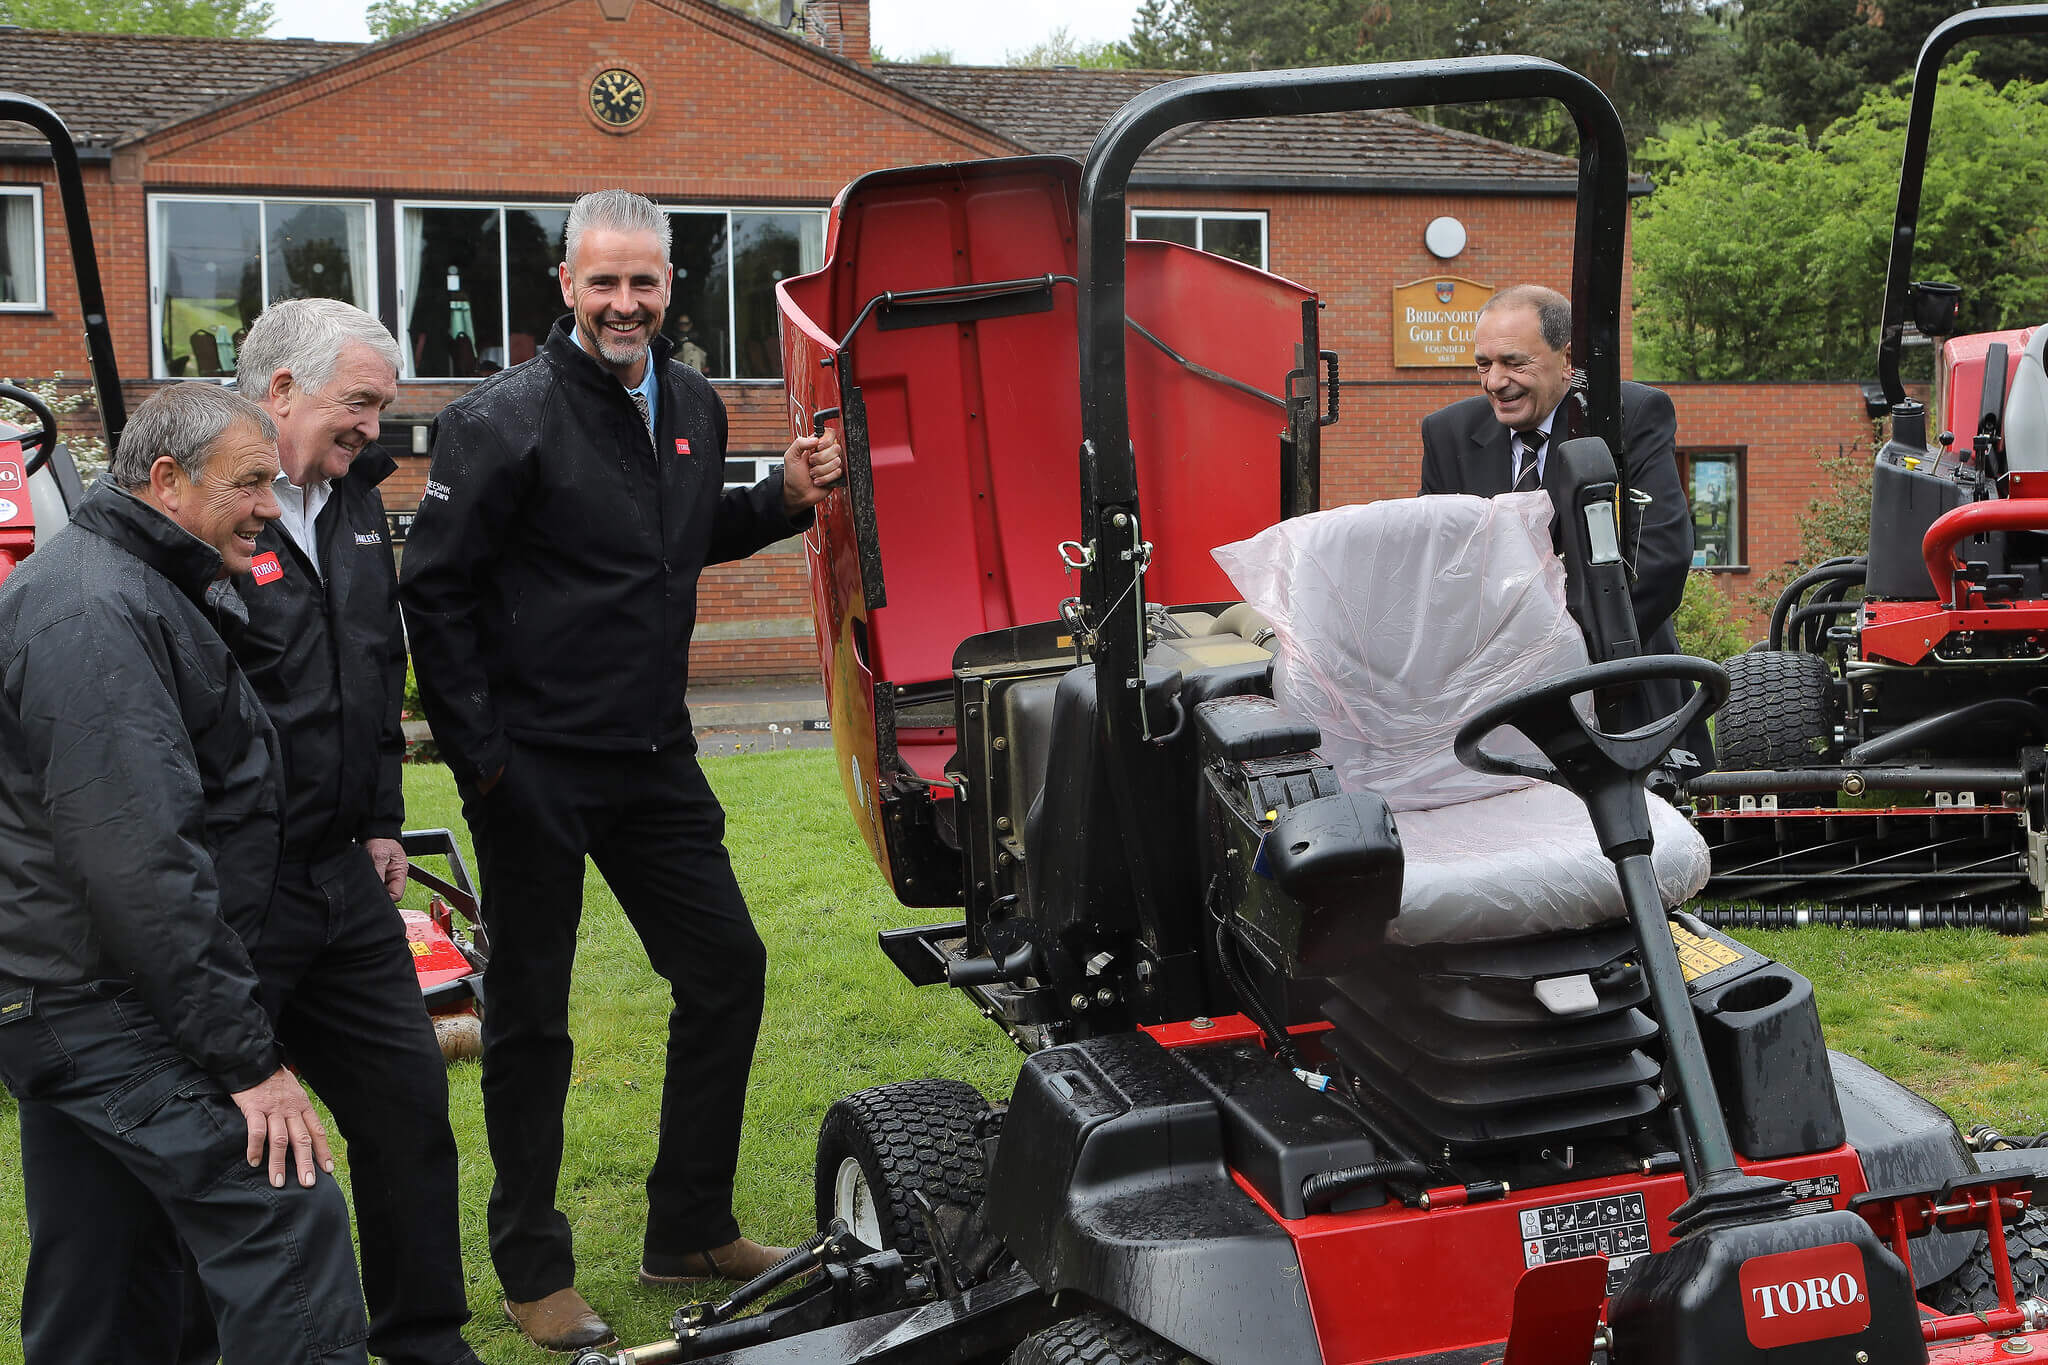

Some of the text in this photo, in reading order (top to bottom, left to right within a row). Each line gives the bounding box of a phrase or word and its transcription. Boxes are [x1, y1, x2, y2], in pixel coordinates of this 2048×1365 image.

[1409, 325, 1476, 342] GOLF CLU
[1425, 345, 1466, 353] FOUNDED
[251, 560, 277, 577] TORO
[1752, 1272, 1859, 1319] TORO
